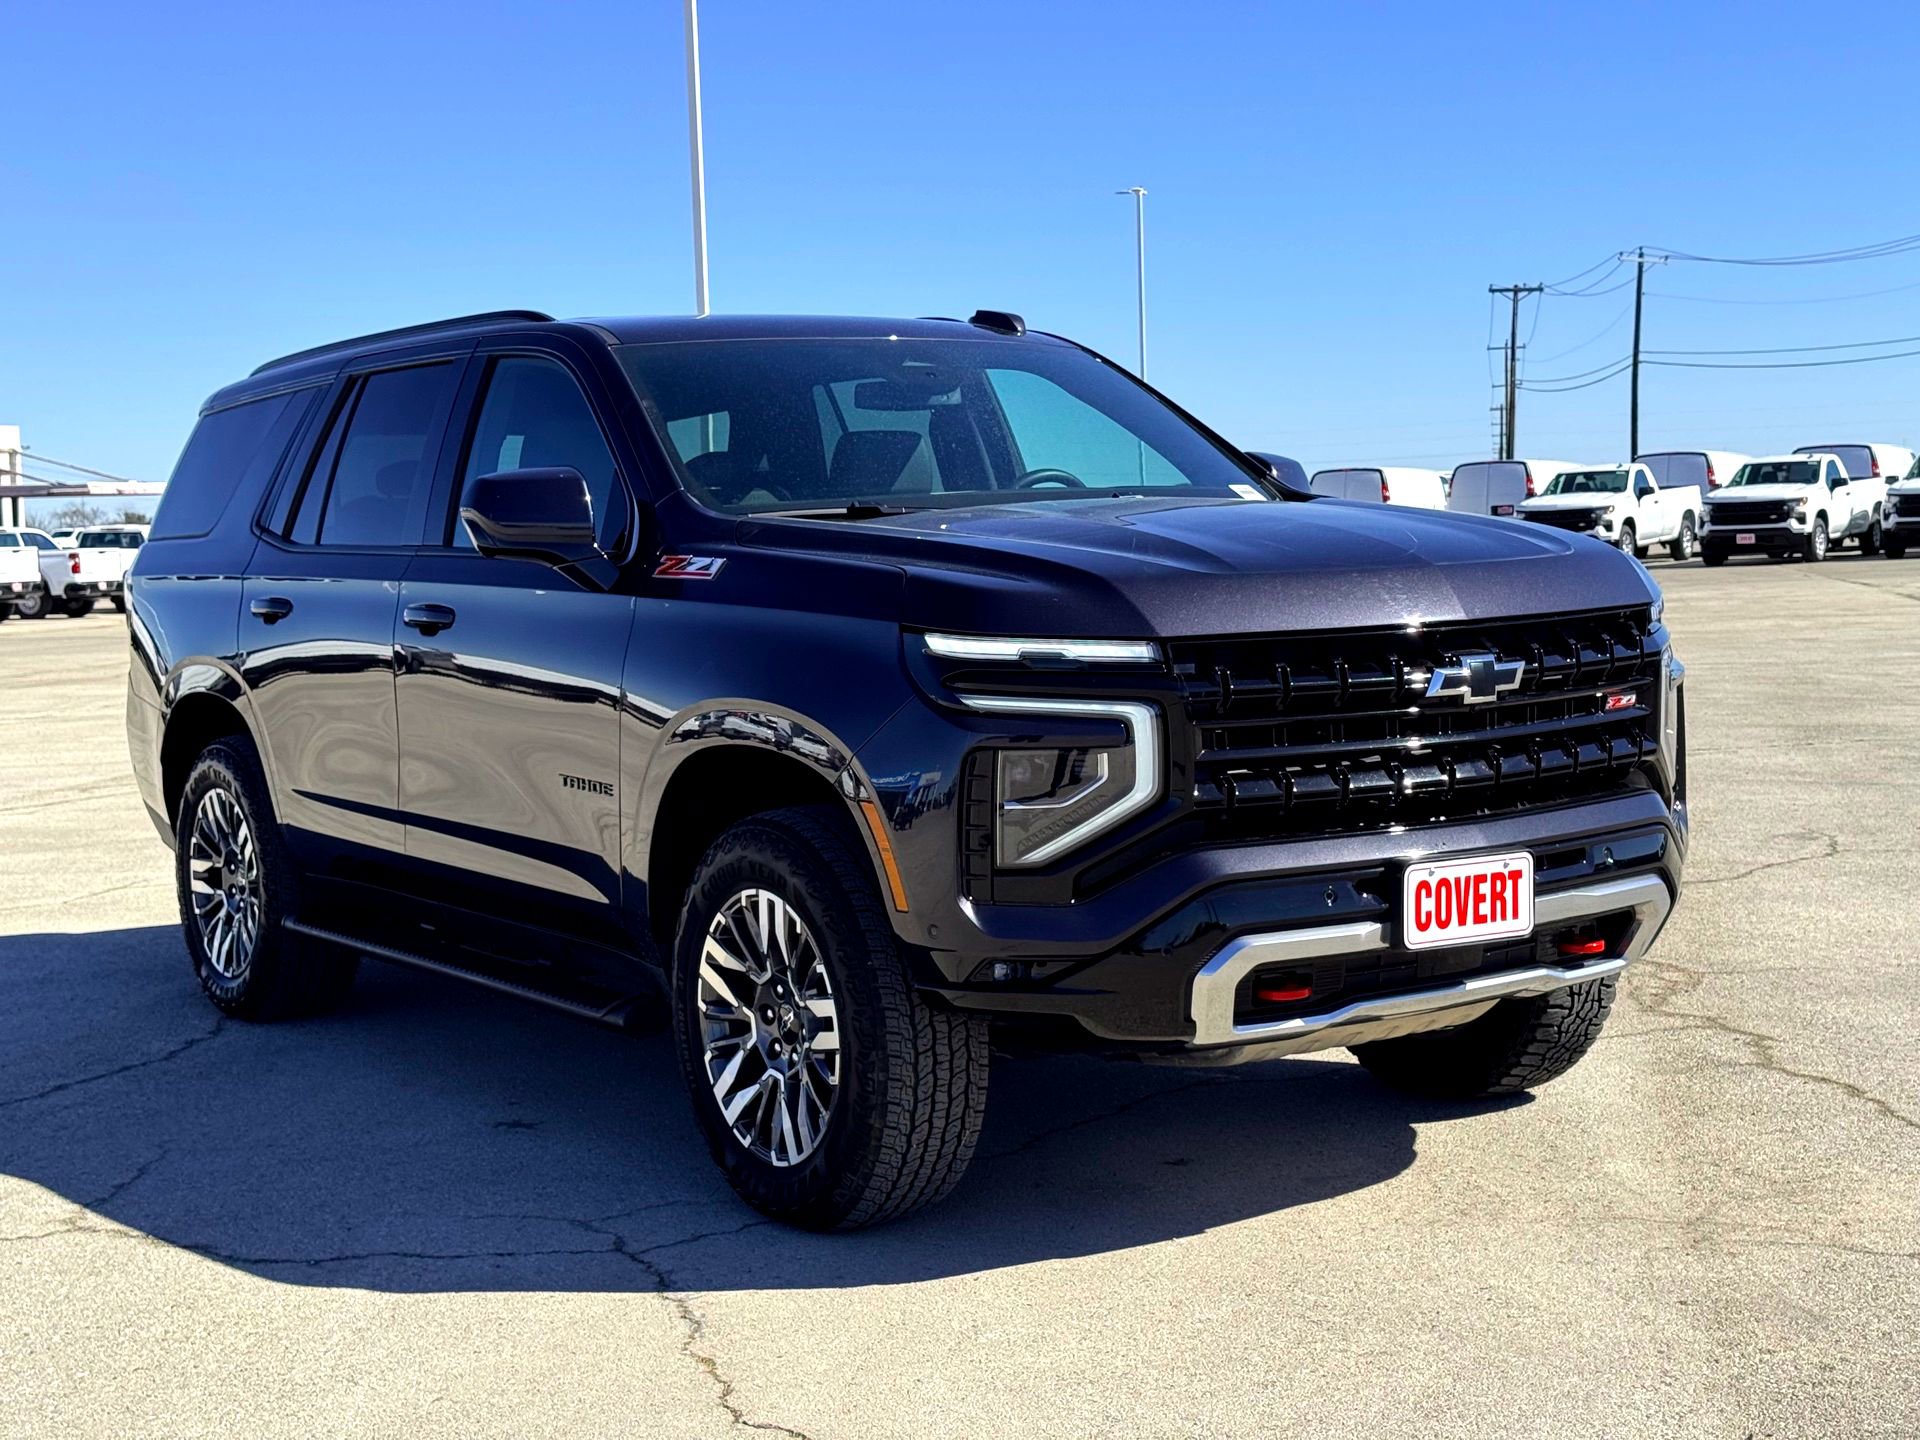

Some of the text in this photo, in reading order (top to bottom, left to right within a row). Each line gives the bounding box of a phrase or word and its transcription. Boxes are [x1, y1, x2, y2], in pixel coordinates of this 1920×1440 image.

[652, 555, 728, 579] Z71
[559, 773, 614, 797] TAHOE
[1415, 869, 1523, 932] COVERT
